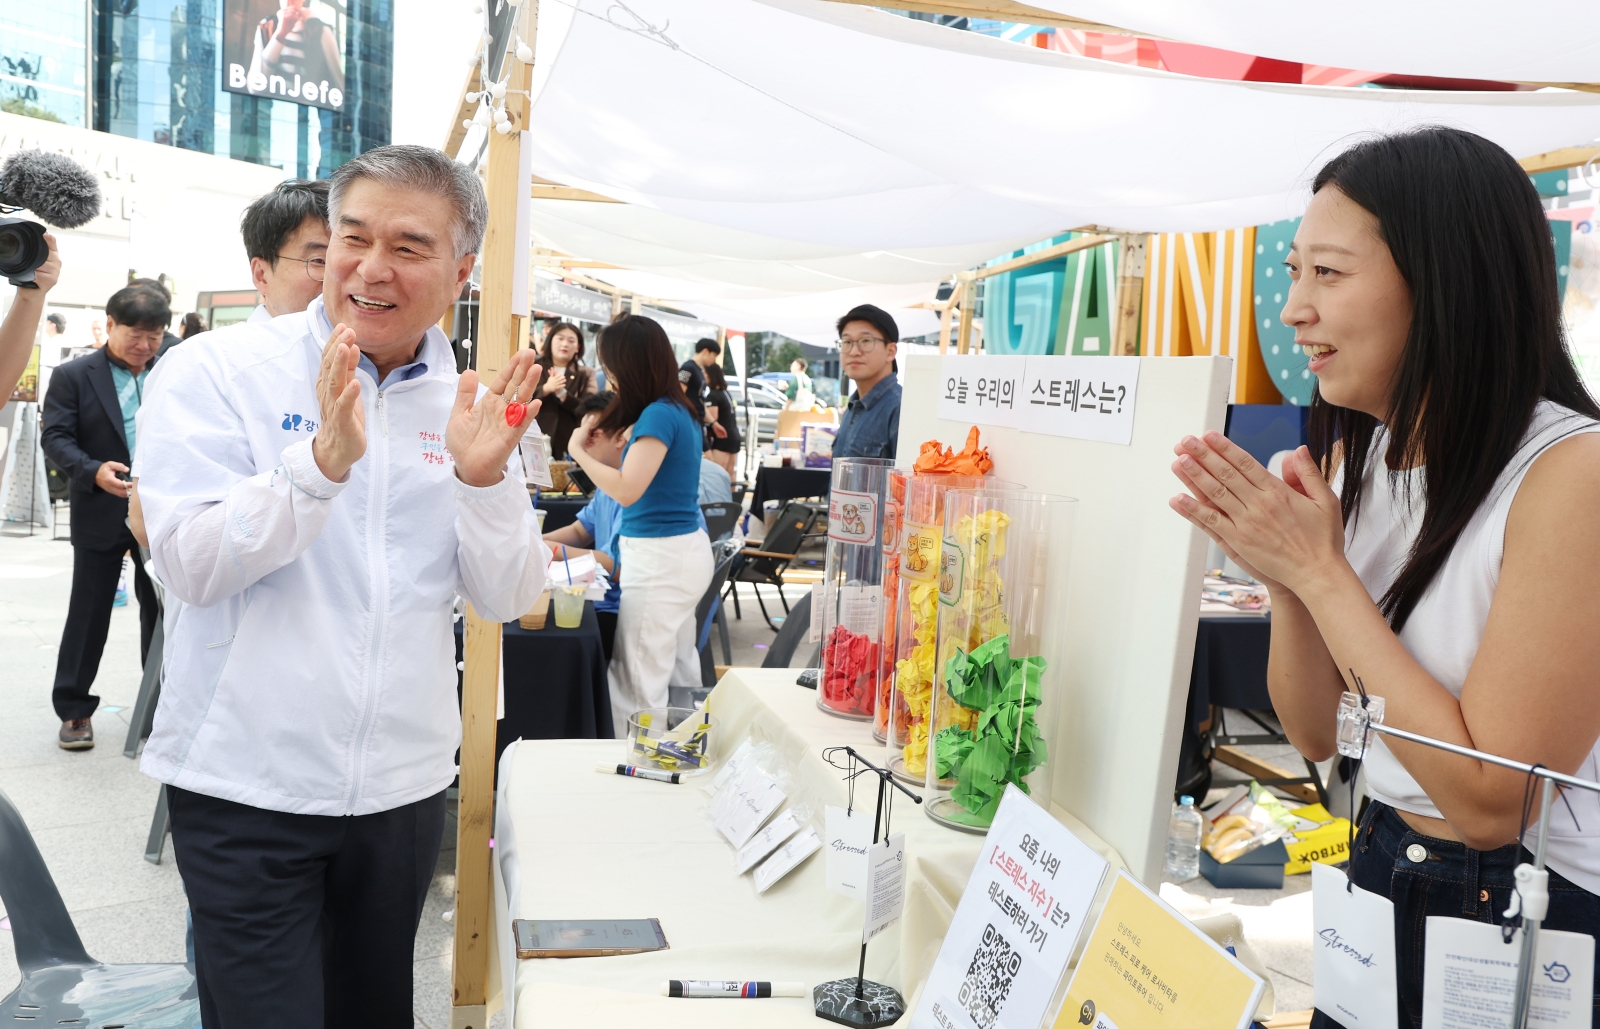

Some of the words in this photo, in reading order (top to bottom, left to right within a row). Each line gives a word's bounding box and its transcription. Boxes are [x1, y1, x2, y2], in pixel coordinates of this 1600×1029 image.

[229, 63, 343, 107] BenJefe
[945, 376, 969, 404] 오늘
[975, 378, 1015, 410] 우리의
[1030, 379, 1126, 414] 스트레스는?
[422, 451, 445, 465] 강남
[1019, 834, 1040, 865] 요즘,
[1040, 850, 1061, 880] 나의
[1298, 841, 1351, 865] RTBOX
[988, 881, 1030, 934] 테스트하러
[1026, 920, 1048, 953] 가기
[1110, 938, 1130, 959] 스트레스
[1129, 954, 1141, 969] 피로
[1082, 1004, 1093, 1021] Ch
